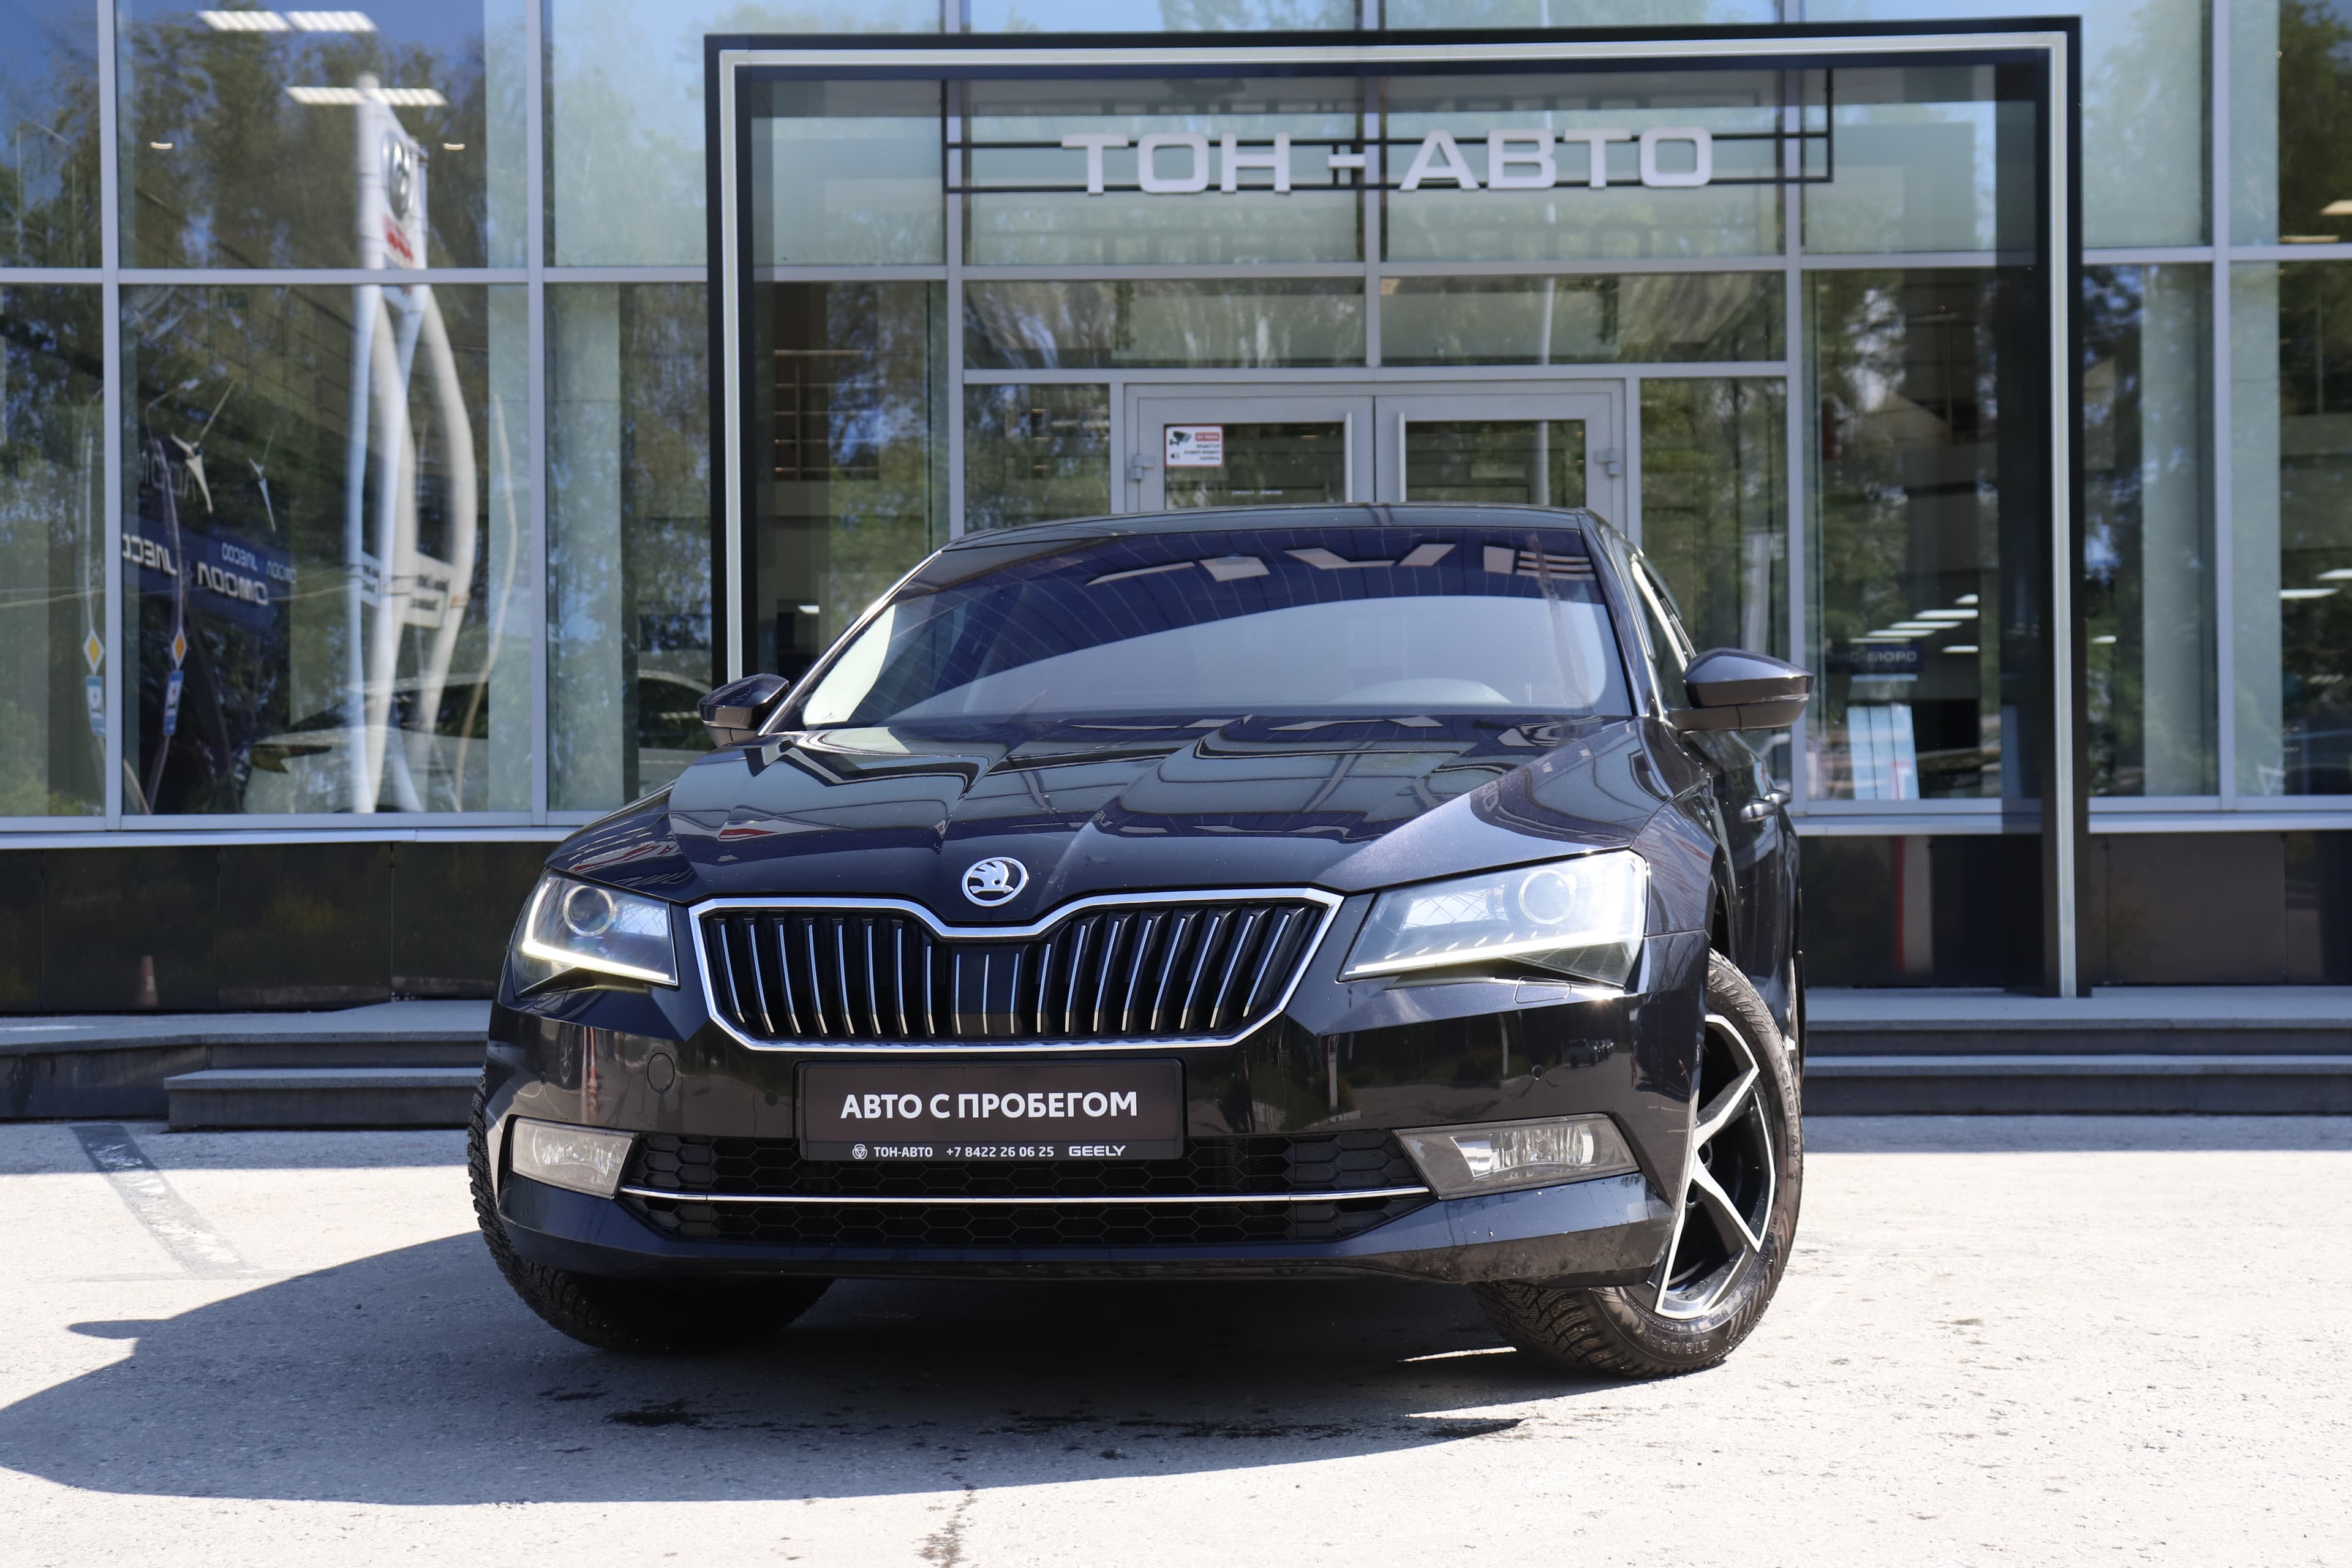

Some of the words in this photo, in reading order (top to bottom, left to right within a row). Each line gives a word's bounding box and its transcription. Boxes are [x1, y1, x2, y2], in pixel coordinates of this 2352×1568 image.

[1061, 131, 1291, 195] ТОН
[1398, 126, 1713, 192] АВТО
[840, 1094, 922, 1119] АВТО
[930, 1093, 951, 1119] С
[958, 1091, 1137, 1118] ПРОБЕГОМ
[873, 1147, 933, 1158] ТОН-АВТО
[946, 1147, 962, 1158] +7
[965, 1147, 997, 1158] 8422
[1000, 1146, 1016, 1158] 26
[1019, 1146, 1035, 1157] 06
[1038, 1146, 1054, 1157] 25
[1068, 1145, 1126, 1157] GEELY
